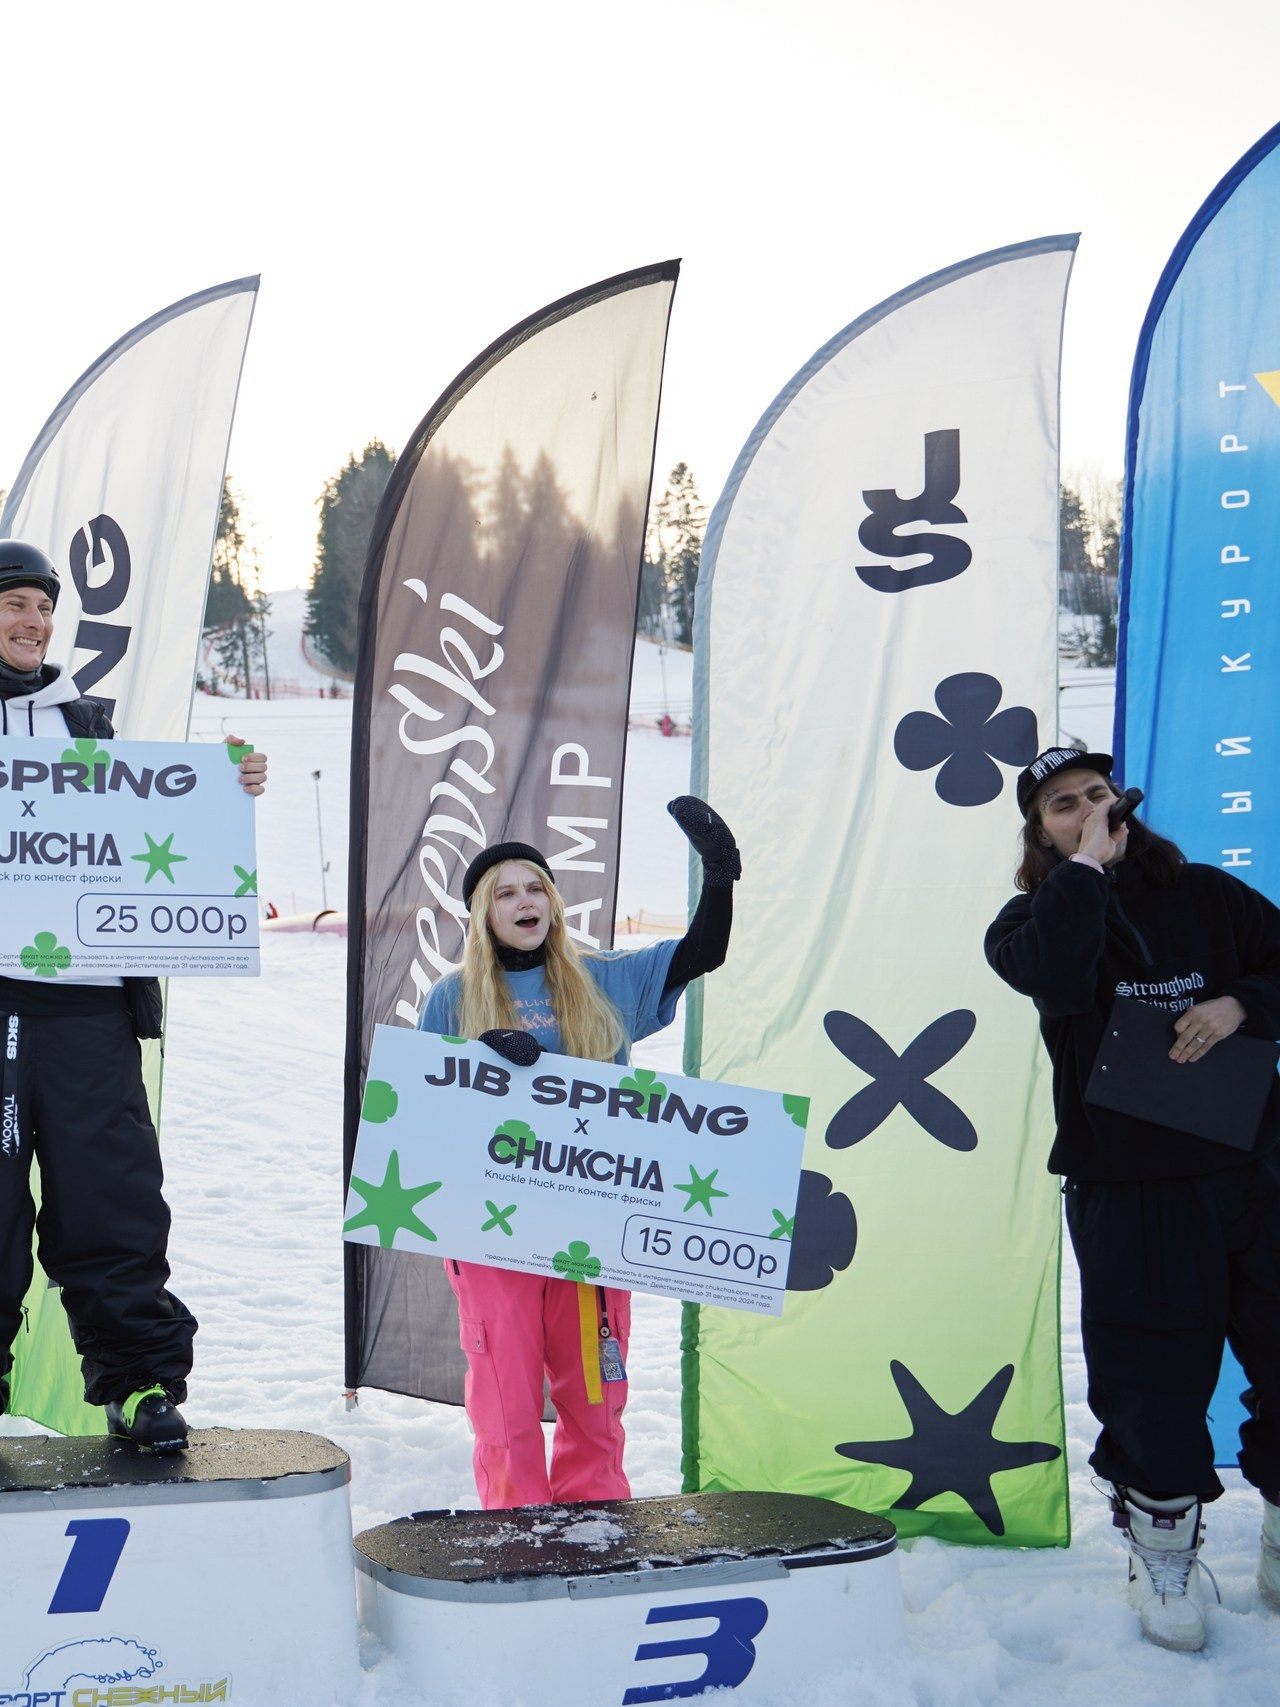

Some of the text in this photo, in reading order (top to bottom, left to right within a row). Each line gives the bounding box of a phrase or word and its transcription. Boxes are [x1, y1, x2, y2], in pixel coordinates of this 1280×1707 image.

[1215, 380, 1252, 867] НЫЙ КУРОРТ
[546, 742, 612, 949] AMP
[13, 873, 31, 884] pro
[34, 873, 76, 882] контест
[79, 873, 122, 884] фриски
[95, 904, 139, 933] 25
[116, 954, 179, 962] интернет-магазине
[1114, 971, 1205, 997] Stronghold
[6, 1014, 19, 1060] SKIS
[424, 1056, 749, 1136] JIB SPRING
[487, 1133, 664, 1193] CHUKCHA
[485, 1169, 662, 1208] Knuckle Huck pro контест фриски
[639, 1227, 672, 1256] 15
[484, 1253, 526, 1265] продуктовую
[650, 1281, 694, 1296] Действителен
[712, 1292, 737, 1303] августа
[532, 1253, 571, 1265] Сертификат
[571, 1260, 593, 1270] можно
[593, 1264, 637, 1278] использовать
[642, 1273, 704, 1289] интернет-магазине
[705, 1283, 750, 1297] chukchas.com
[46, 1517, 131, 1615] 1
[622, 1596, 769, 1706] 3
[72, 1678, 228, 1706] СНЕЖНЫЙ
